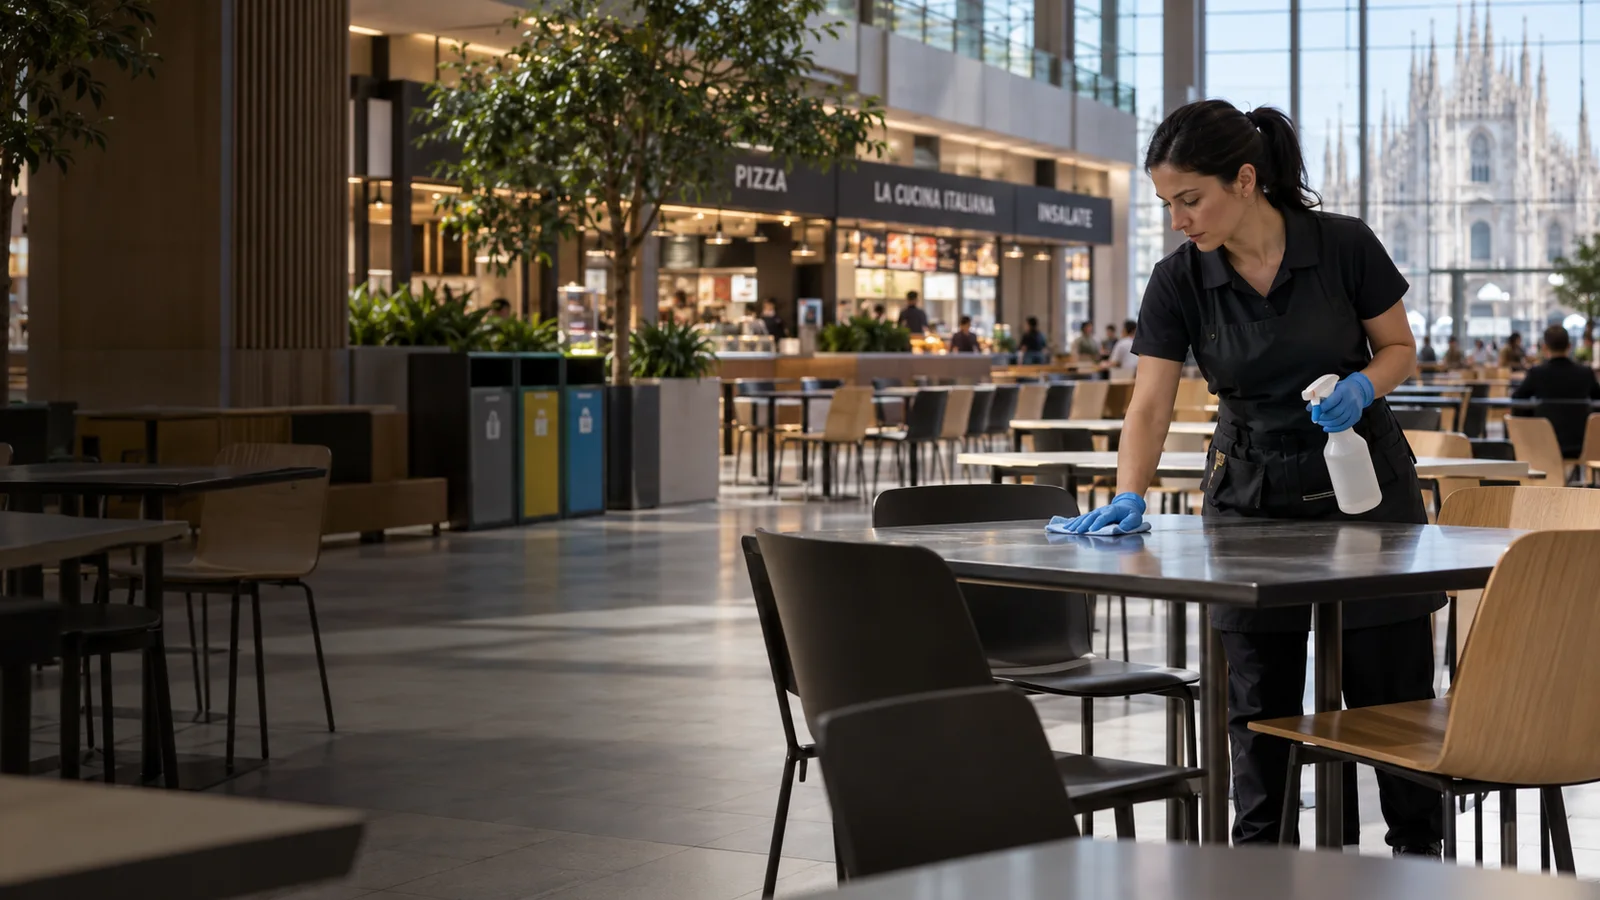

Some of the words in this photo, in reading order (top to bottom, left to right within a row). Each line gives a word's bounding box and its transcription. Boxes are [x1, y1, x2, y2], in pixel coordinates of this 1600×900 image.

[735, 164, 788, 193] PIZZA
[874, 181, 892, 203] LA
[894, 183, 942, 210] CUCINA
[943, 189, 996, 216] ITALIANA
[1037, 202, 1093, 229] INSALATE
